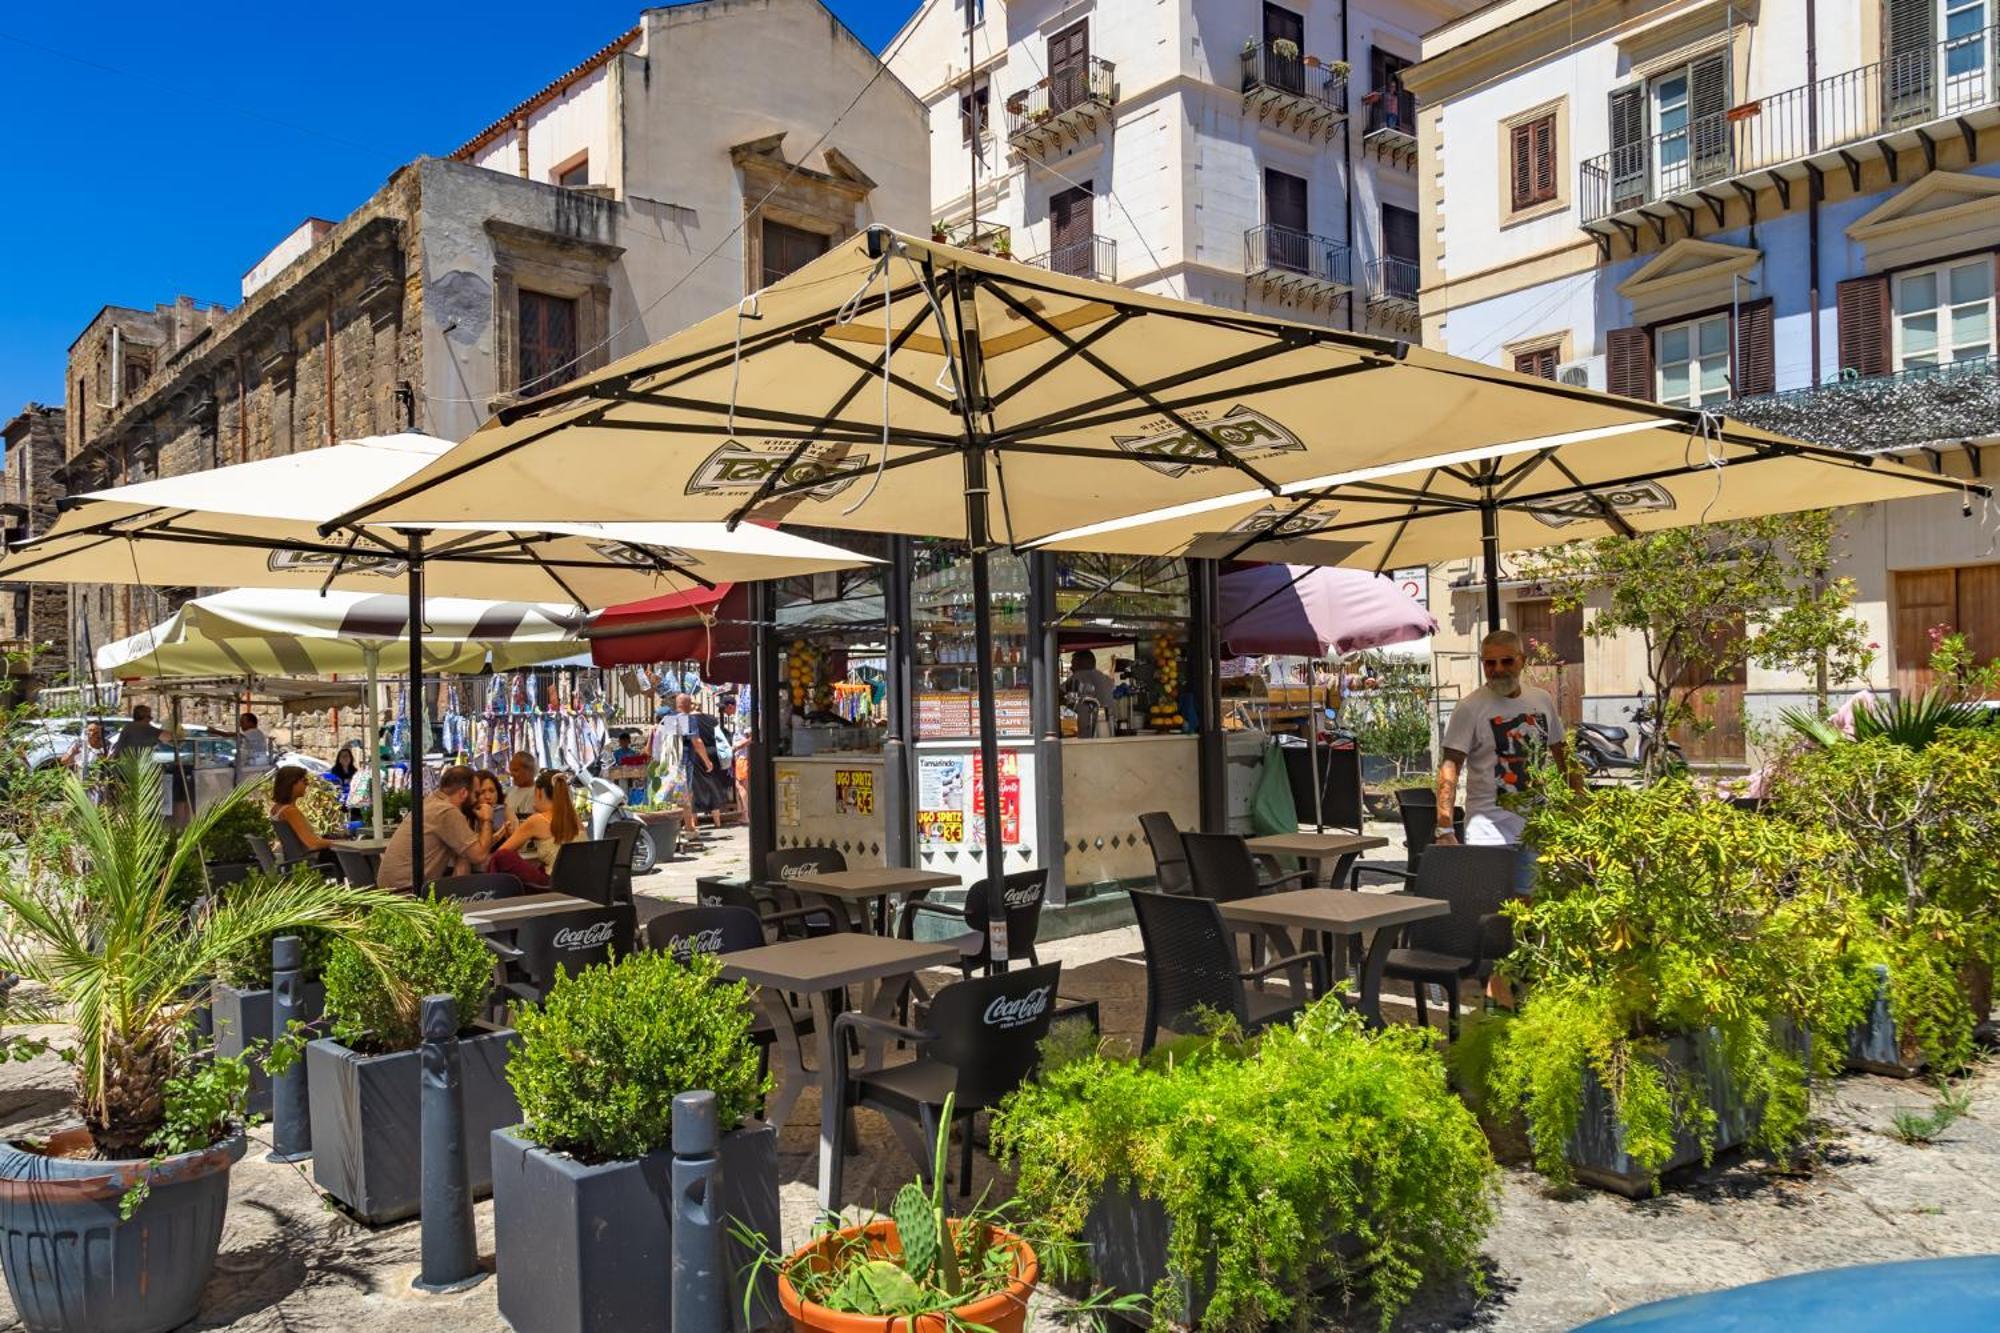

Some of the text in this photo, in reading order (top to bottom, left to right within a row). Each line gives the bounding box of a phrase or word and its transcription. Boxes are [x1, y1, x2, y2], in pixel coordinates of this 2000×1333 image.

[920, 759, 955, 767] Tamarindo
[945, 826, 961, 841] 3€
[552, 920, 616, 948] Coca-Cola
[983, 985, 1051, 1024] Coca-Cola
